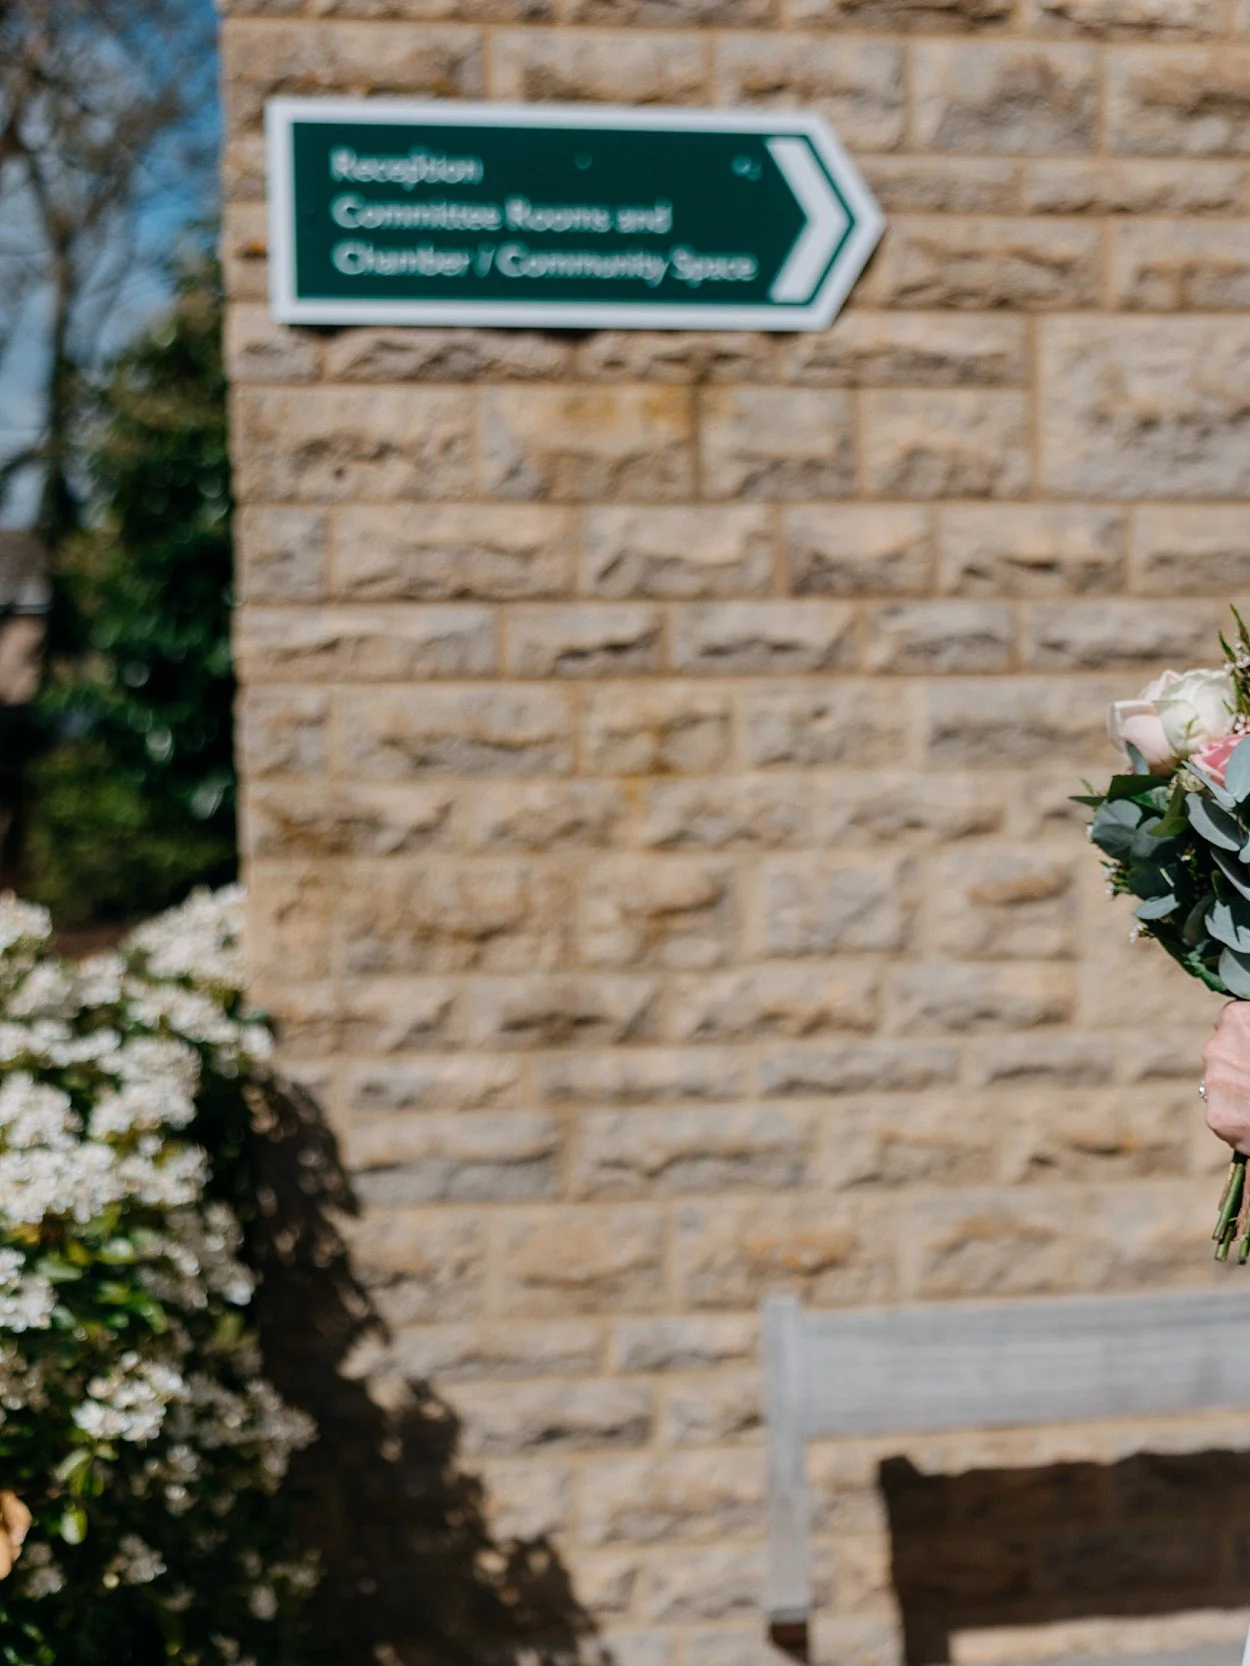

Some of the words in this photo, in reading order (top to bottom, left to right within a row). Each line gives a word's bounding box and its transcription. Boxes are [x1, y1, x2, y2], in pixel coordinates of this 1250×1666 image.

[329, 145, 484, 190] Reception
[331, 192, 501, 229] Committee
[505, 195, 612, 232] Rooms
[615, 199, 672, 233] and
[331, 239, 471, 275] Chamber
[474, 242, 495, 276] /
[497, 241, 669, 286] Community
[670, 245, 757, 286] Space
